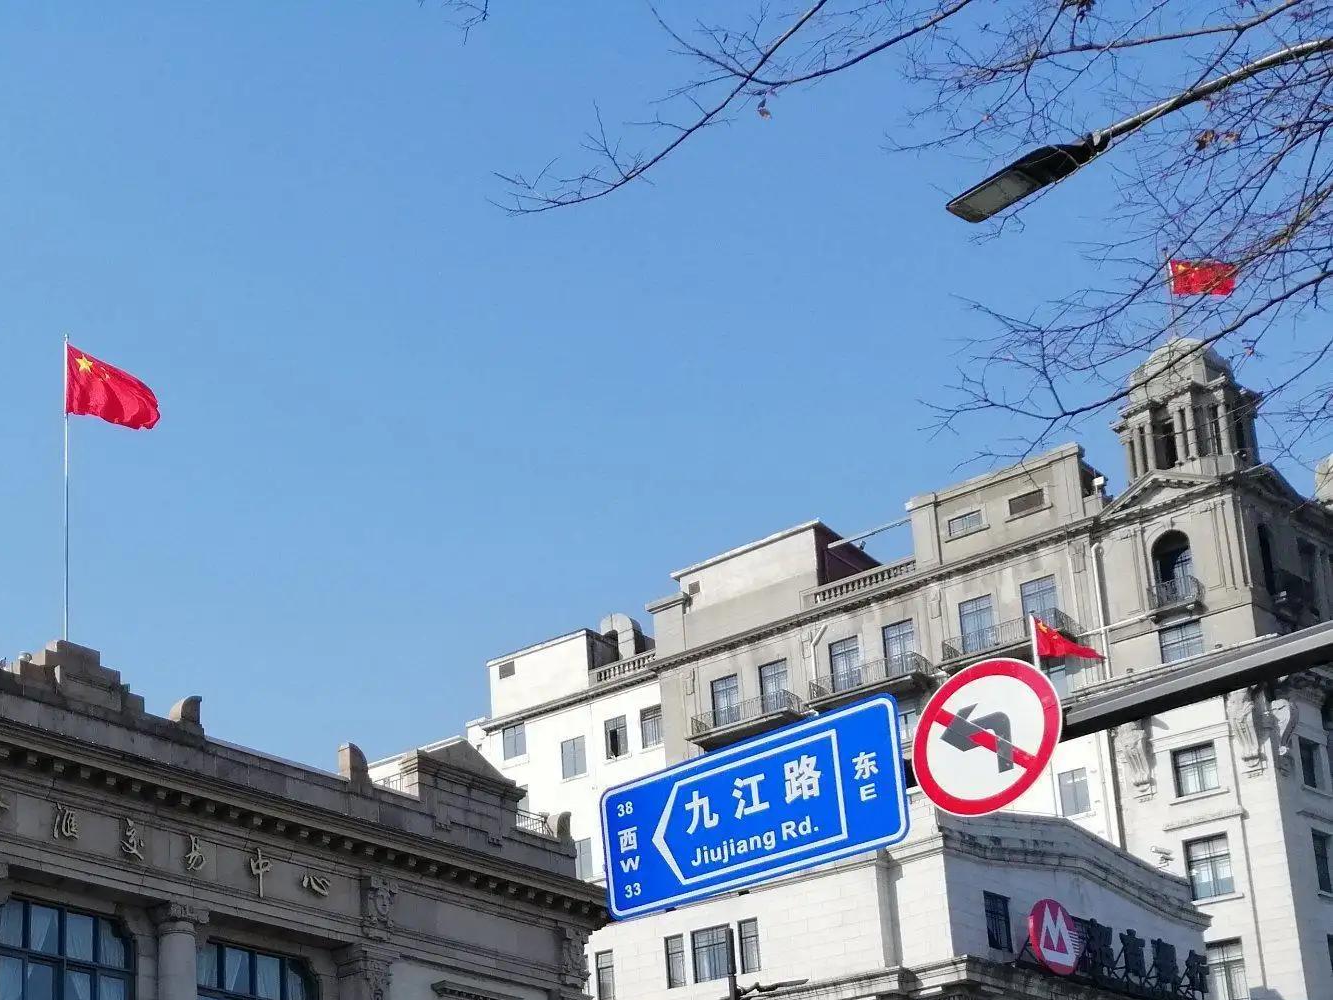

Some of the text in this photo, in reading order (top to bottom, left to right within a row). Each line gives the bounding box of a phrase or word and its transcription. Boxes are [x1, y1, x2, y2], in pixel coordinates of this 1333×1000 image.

[850, 750, 879, 780] 东
[684, 754, 823, 836] 九江路
[860, 783, 879, 802] E
[617, 800, 634, 818] 38
[617, 825, 640, 853] 西
[690, 816, 820, 868] Jiujiang Rd.
[619, 855, 641, 873] W
[623, 881, 642, 899] 33
